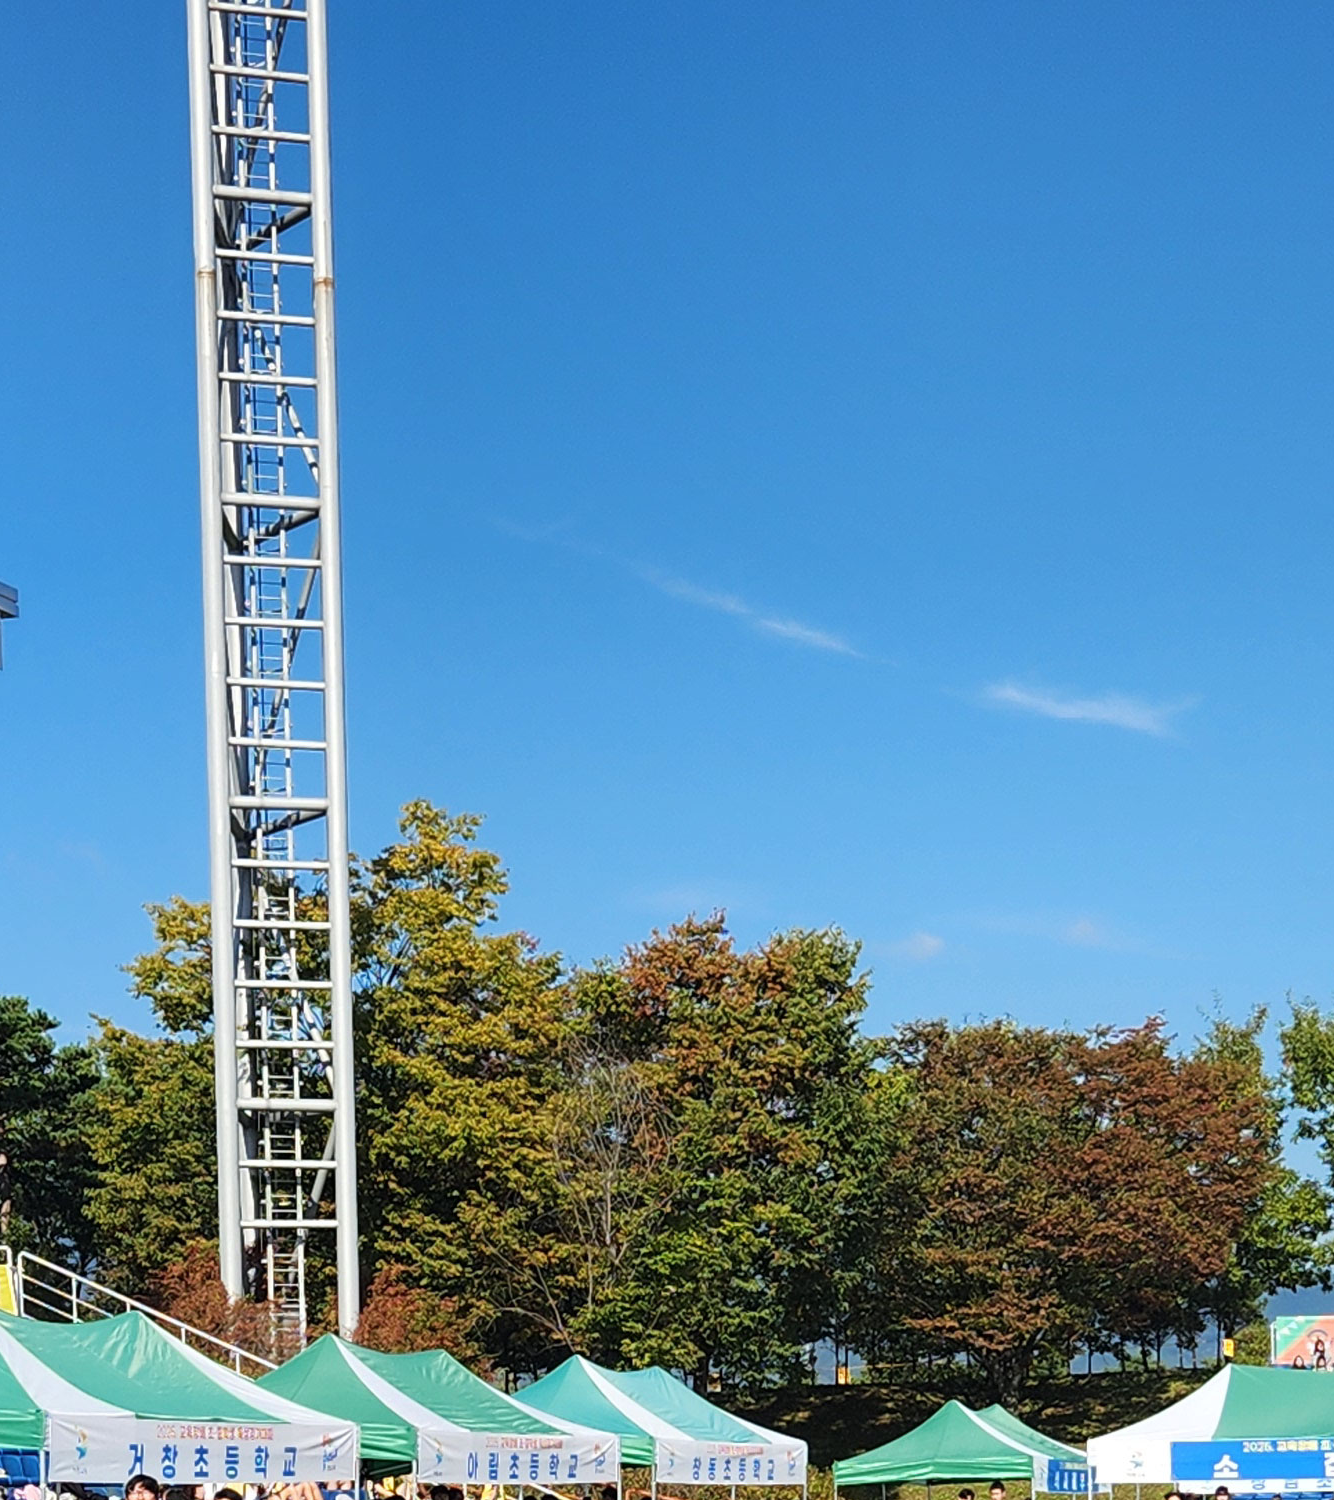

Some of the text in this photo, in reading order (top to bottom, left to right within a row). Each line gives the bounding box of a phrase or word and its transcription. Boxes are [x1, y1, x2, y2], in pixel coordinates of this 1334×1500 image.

[128, 1443, 297, 1479] 거창초등학교
[468, 1452, 579, 1480] 아림초등학교
[693, 1456, 774, 1481] 창동초등학교
